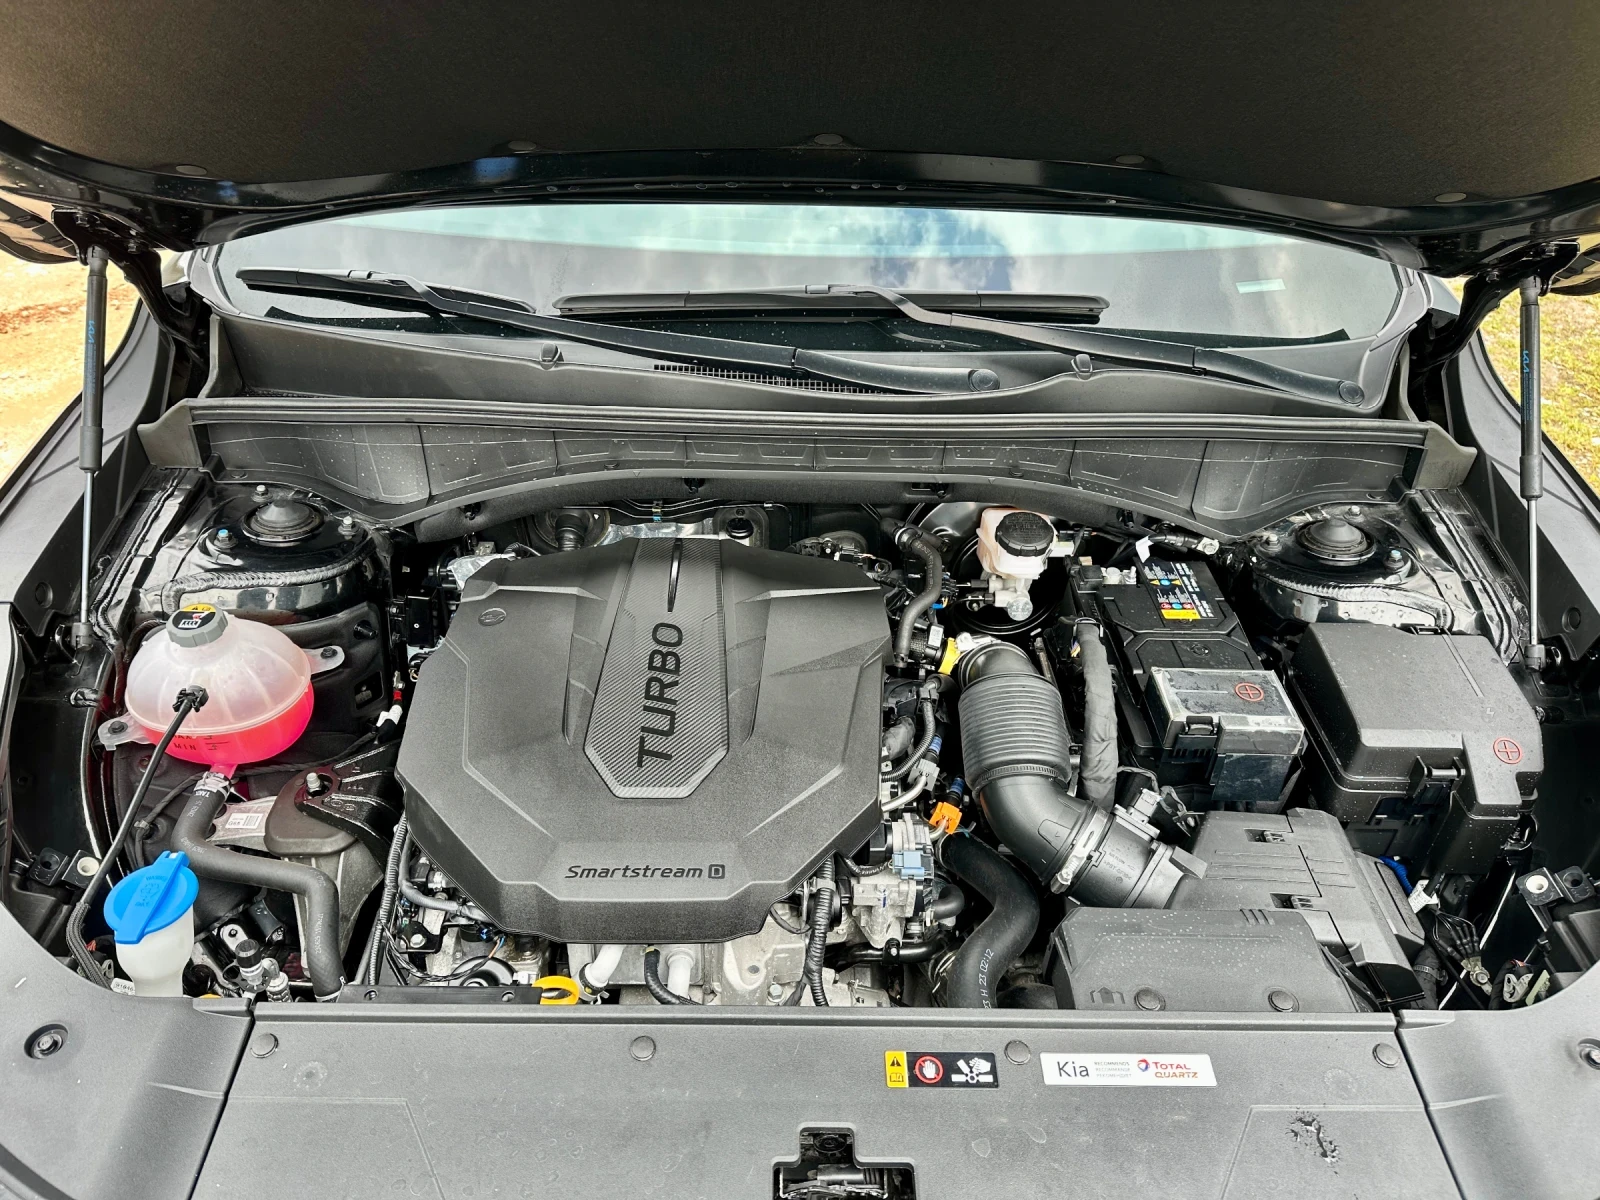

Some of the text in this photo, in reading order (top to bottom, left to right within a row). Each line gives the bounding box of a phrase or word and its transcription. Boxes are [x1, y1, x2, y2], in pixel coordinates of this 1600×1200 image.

[637, 622, 683, 768] TURBO
[173, 742, 197, 751] MIN
[564, 864, 724, 879] Smartstream D
[980, 949, 994, 972] 02:12
[979, 973, 987, 986] 23
[980, 989, 989, 997] H
[1057, 1061, 1090, 1078] Kia
[1152, 1061, 1191, 1070] TOTAL
[1154, 1071, 1199, 1079] QUARTZ
